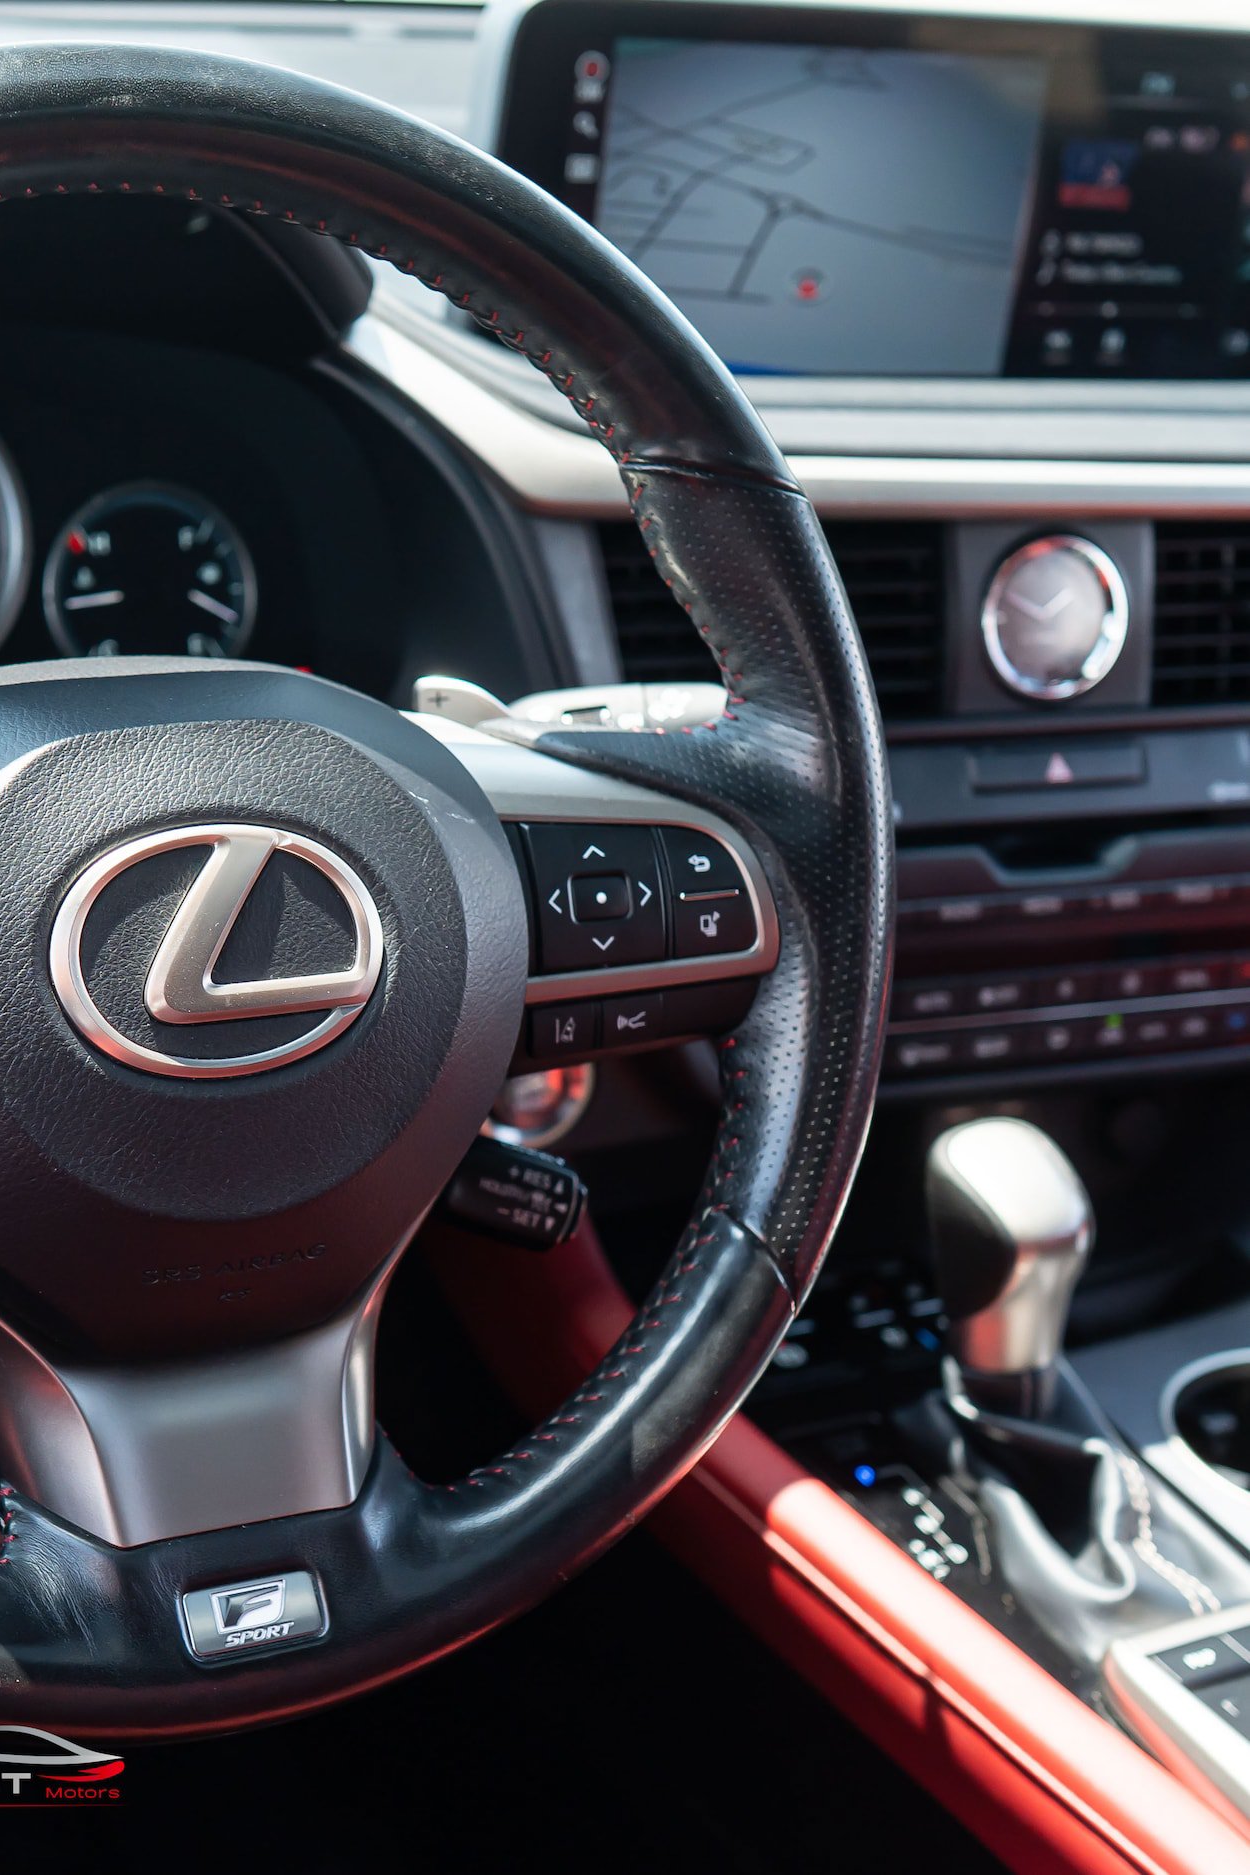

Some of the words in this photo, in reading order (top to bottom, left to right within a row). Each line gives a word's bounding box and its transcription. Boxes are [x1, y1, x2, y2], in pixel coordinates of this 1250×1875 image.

[511, 1207, 541, 1228] SET
[141, 1264, 201, 1285] SRS
[213, 1242, 327, 1277] AIRBAG
[225, 1621, 295, 1648] SPORT
